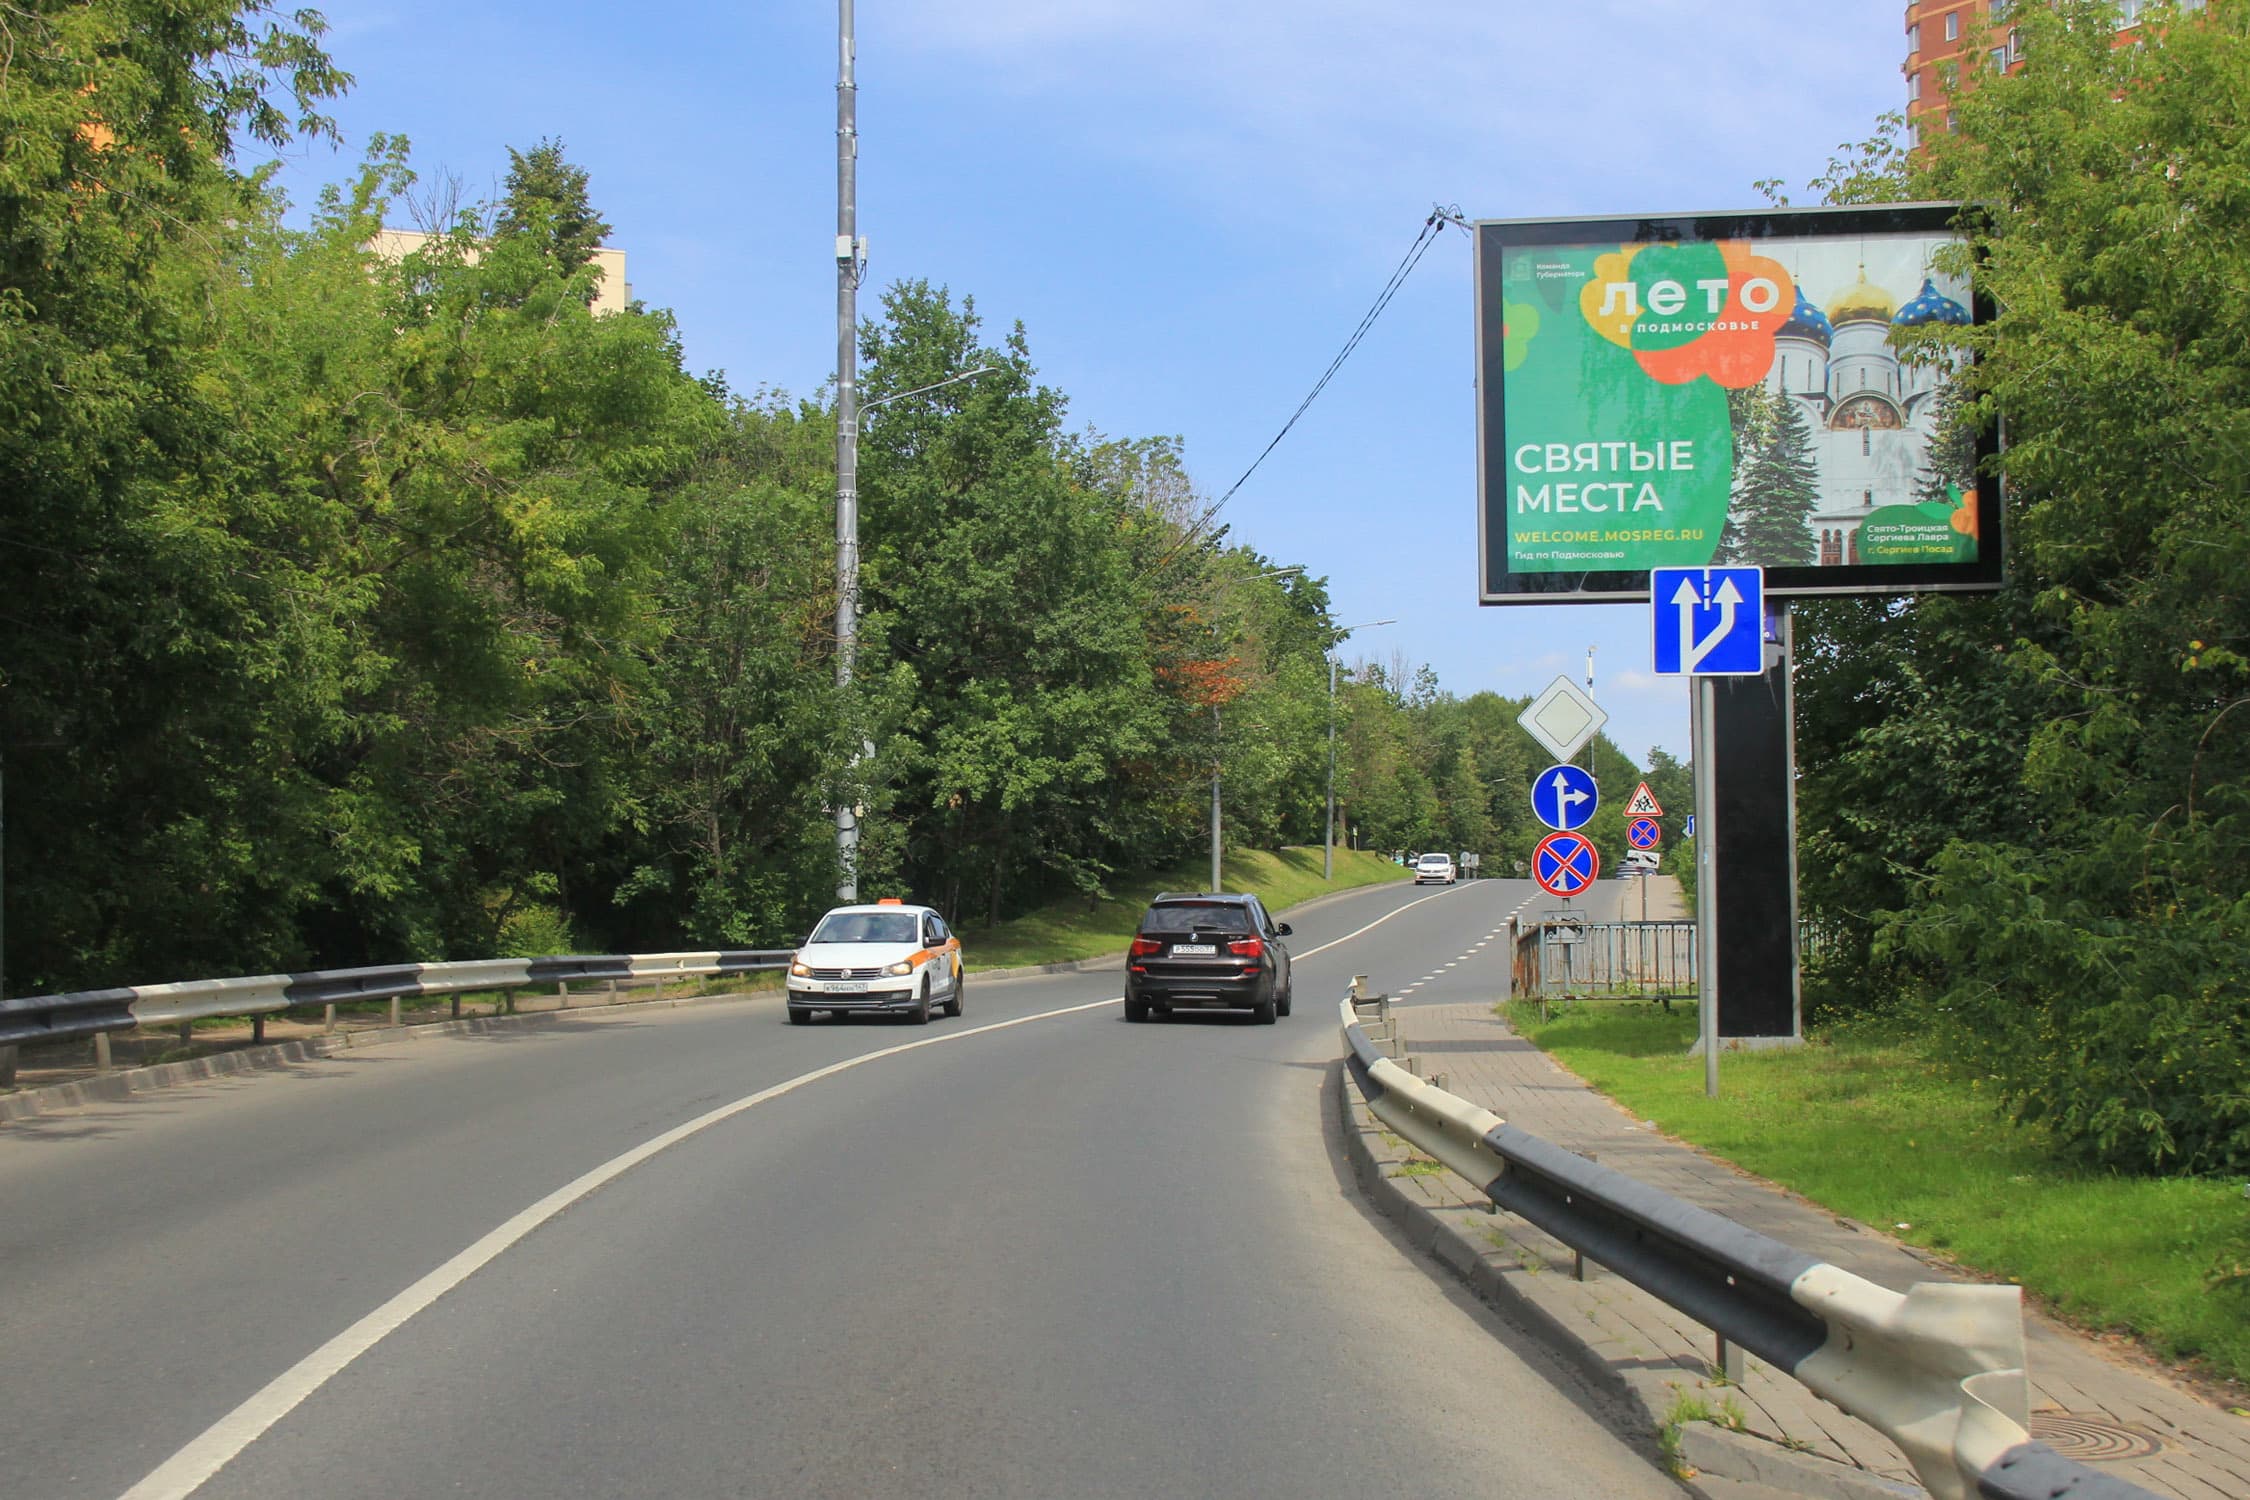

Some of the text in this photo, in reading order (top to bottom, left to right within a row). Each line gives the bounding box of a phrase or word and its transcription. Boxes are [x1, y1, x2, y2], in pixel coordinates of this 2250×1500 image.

[1637, 320, 1760, 333] ПОДМОСКОВЬЕ
[1514, 441, 1694, 474] СВЯТЫЕ
[1517, 482, 1664, 514] МЕСТА
[1866, 524, 1949, 534] Свято-Троицкая
[1514, 529, 1704, 544] WELCOME.MOSREG.RU
[1866, 533, 1949, 543] Сергиева Лавра
[1515, 550, 1625, 561] Гид по Подмосковью
[1876, 545, 1920, 556] Сергиев
[1921, 545, 1954, 554] Посад
